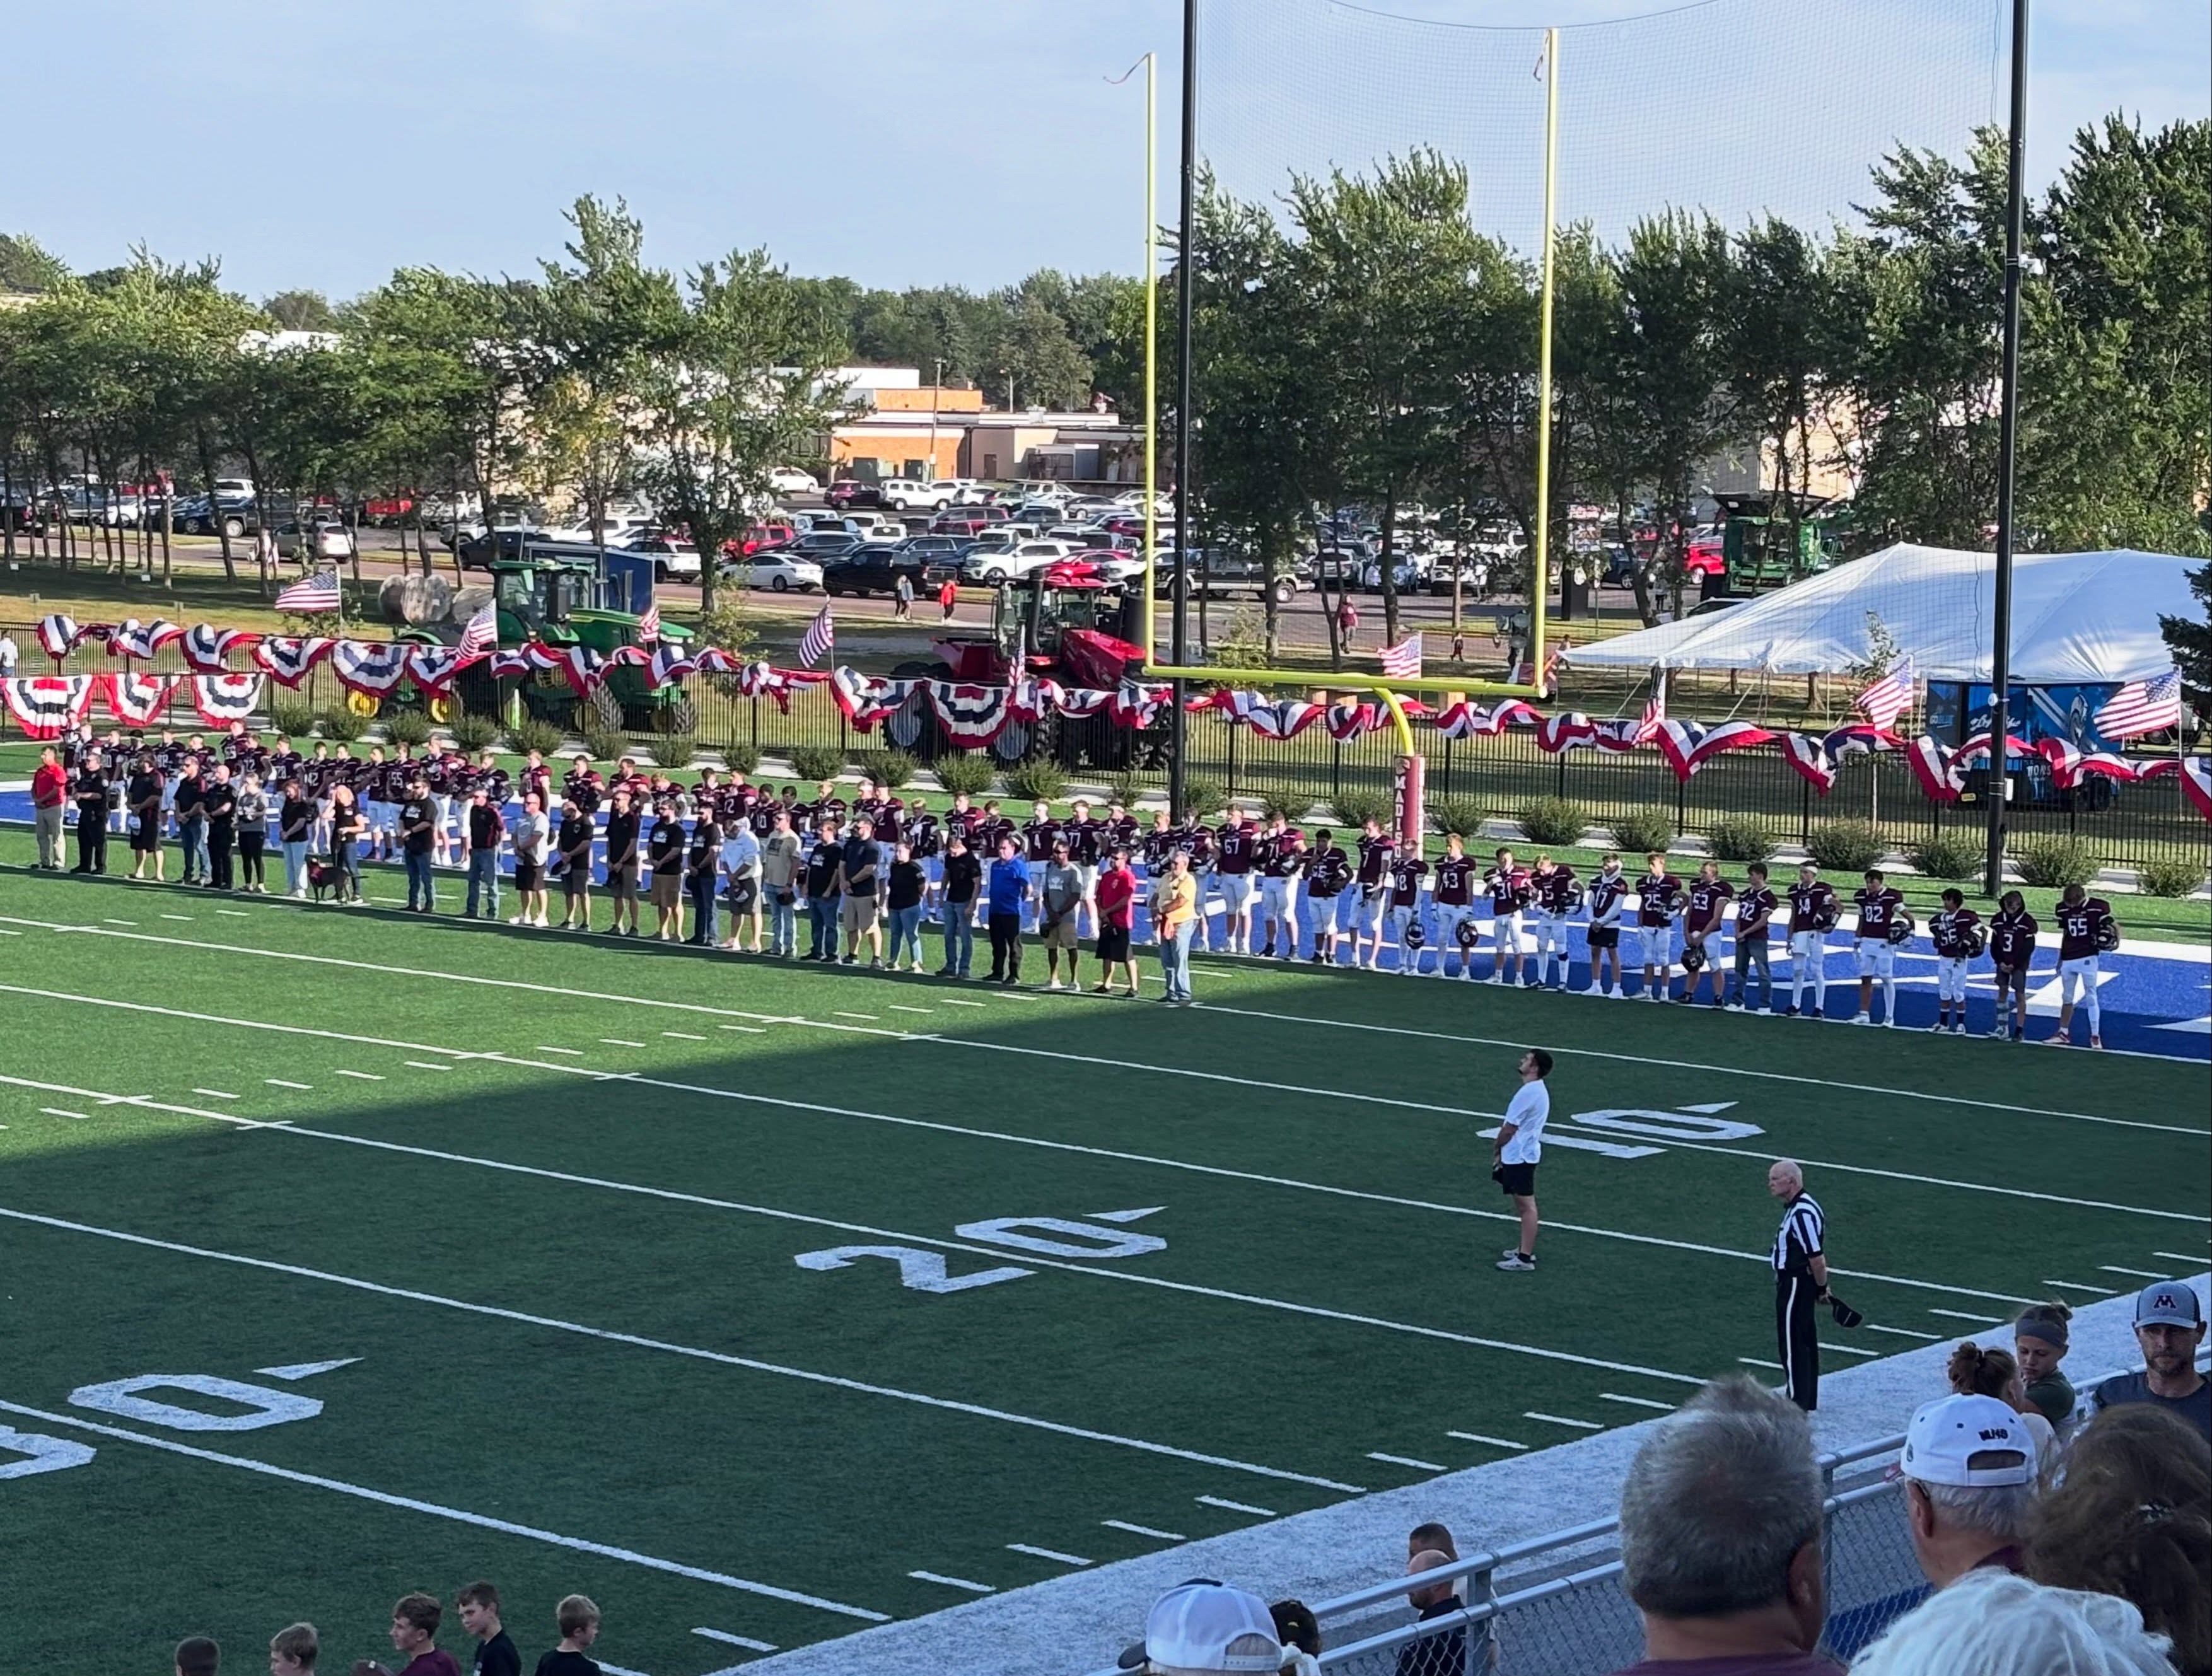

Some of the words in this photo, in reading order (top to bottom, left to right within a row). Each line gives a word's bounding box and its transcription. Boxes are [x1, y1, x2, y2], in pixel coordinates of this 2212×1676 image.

[1394, 776, 1406, 858] MADISO
[950, 822, 967, 839] 50
[1033, 834, 1042, 849] 4
[1068, 832, 1081, 848] 77
[1224, 838, 1240, 854] 67
[1363, 851, 1370, 868] 7
[1496, 882, 1512, 900] 31
[1543, 885, 1554, 900] 5
[1644, 893, 1662, 911] 25
[2068, 917, 2088, 938] 65
[2002, 933, 2013, 952] 3
[794, 1217, 1167, 1294] 20
[2153, 1295, 2177, 1310] M
